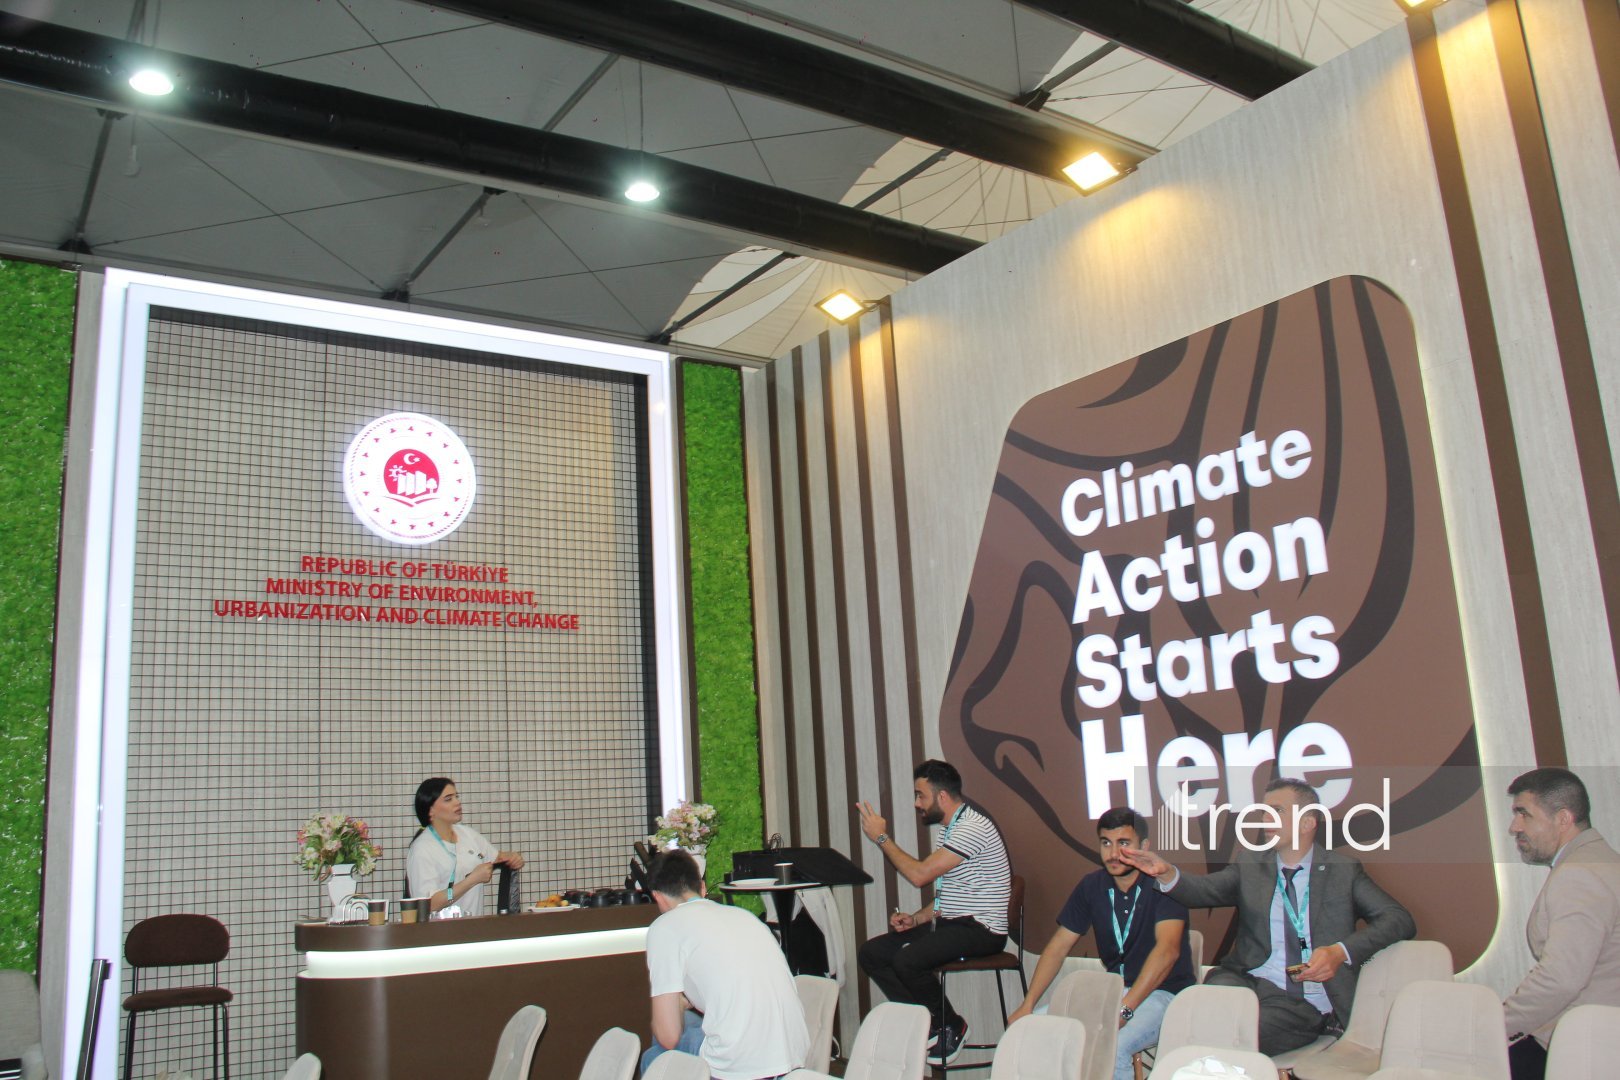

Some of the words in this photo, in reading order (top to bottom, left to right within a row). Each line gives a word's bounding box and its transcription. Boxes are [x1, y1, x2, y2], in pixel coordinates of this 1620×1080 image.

[1061, 429, 1312, 537] Climate
[214, 599, 371, 623] URBANIZATION
[376, 606, 419, 624] AND
[423, 608, 502, 627] CLIMATE
[506, 611, 580, 630] CHANGE
[266, 578, 363, 599] MINISTRY
[368, 583, 394, 600] OF
[400, 585, 538, 608] ENVIRONMENT,
[302, 555, 398, 577] REPUBLIC
[402, 562, 428, 578] OF
[432, 560, 509, 583] TÜRKİYE
[1072, 516, 1329, 624] Action
[1075, 609, 1340, 709] Starts
[1081, 714, 1353, 820] Here
